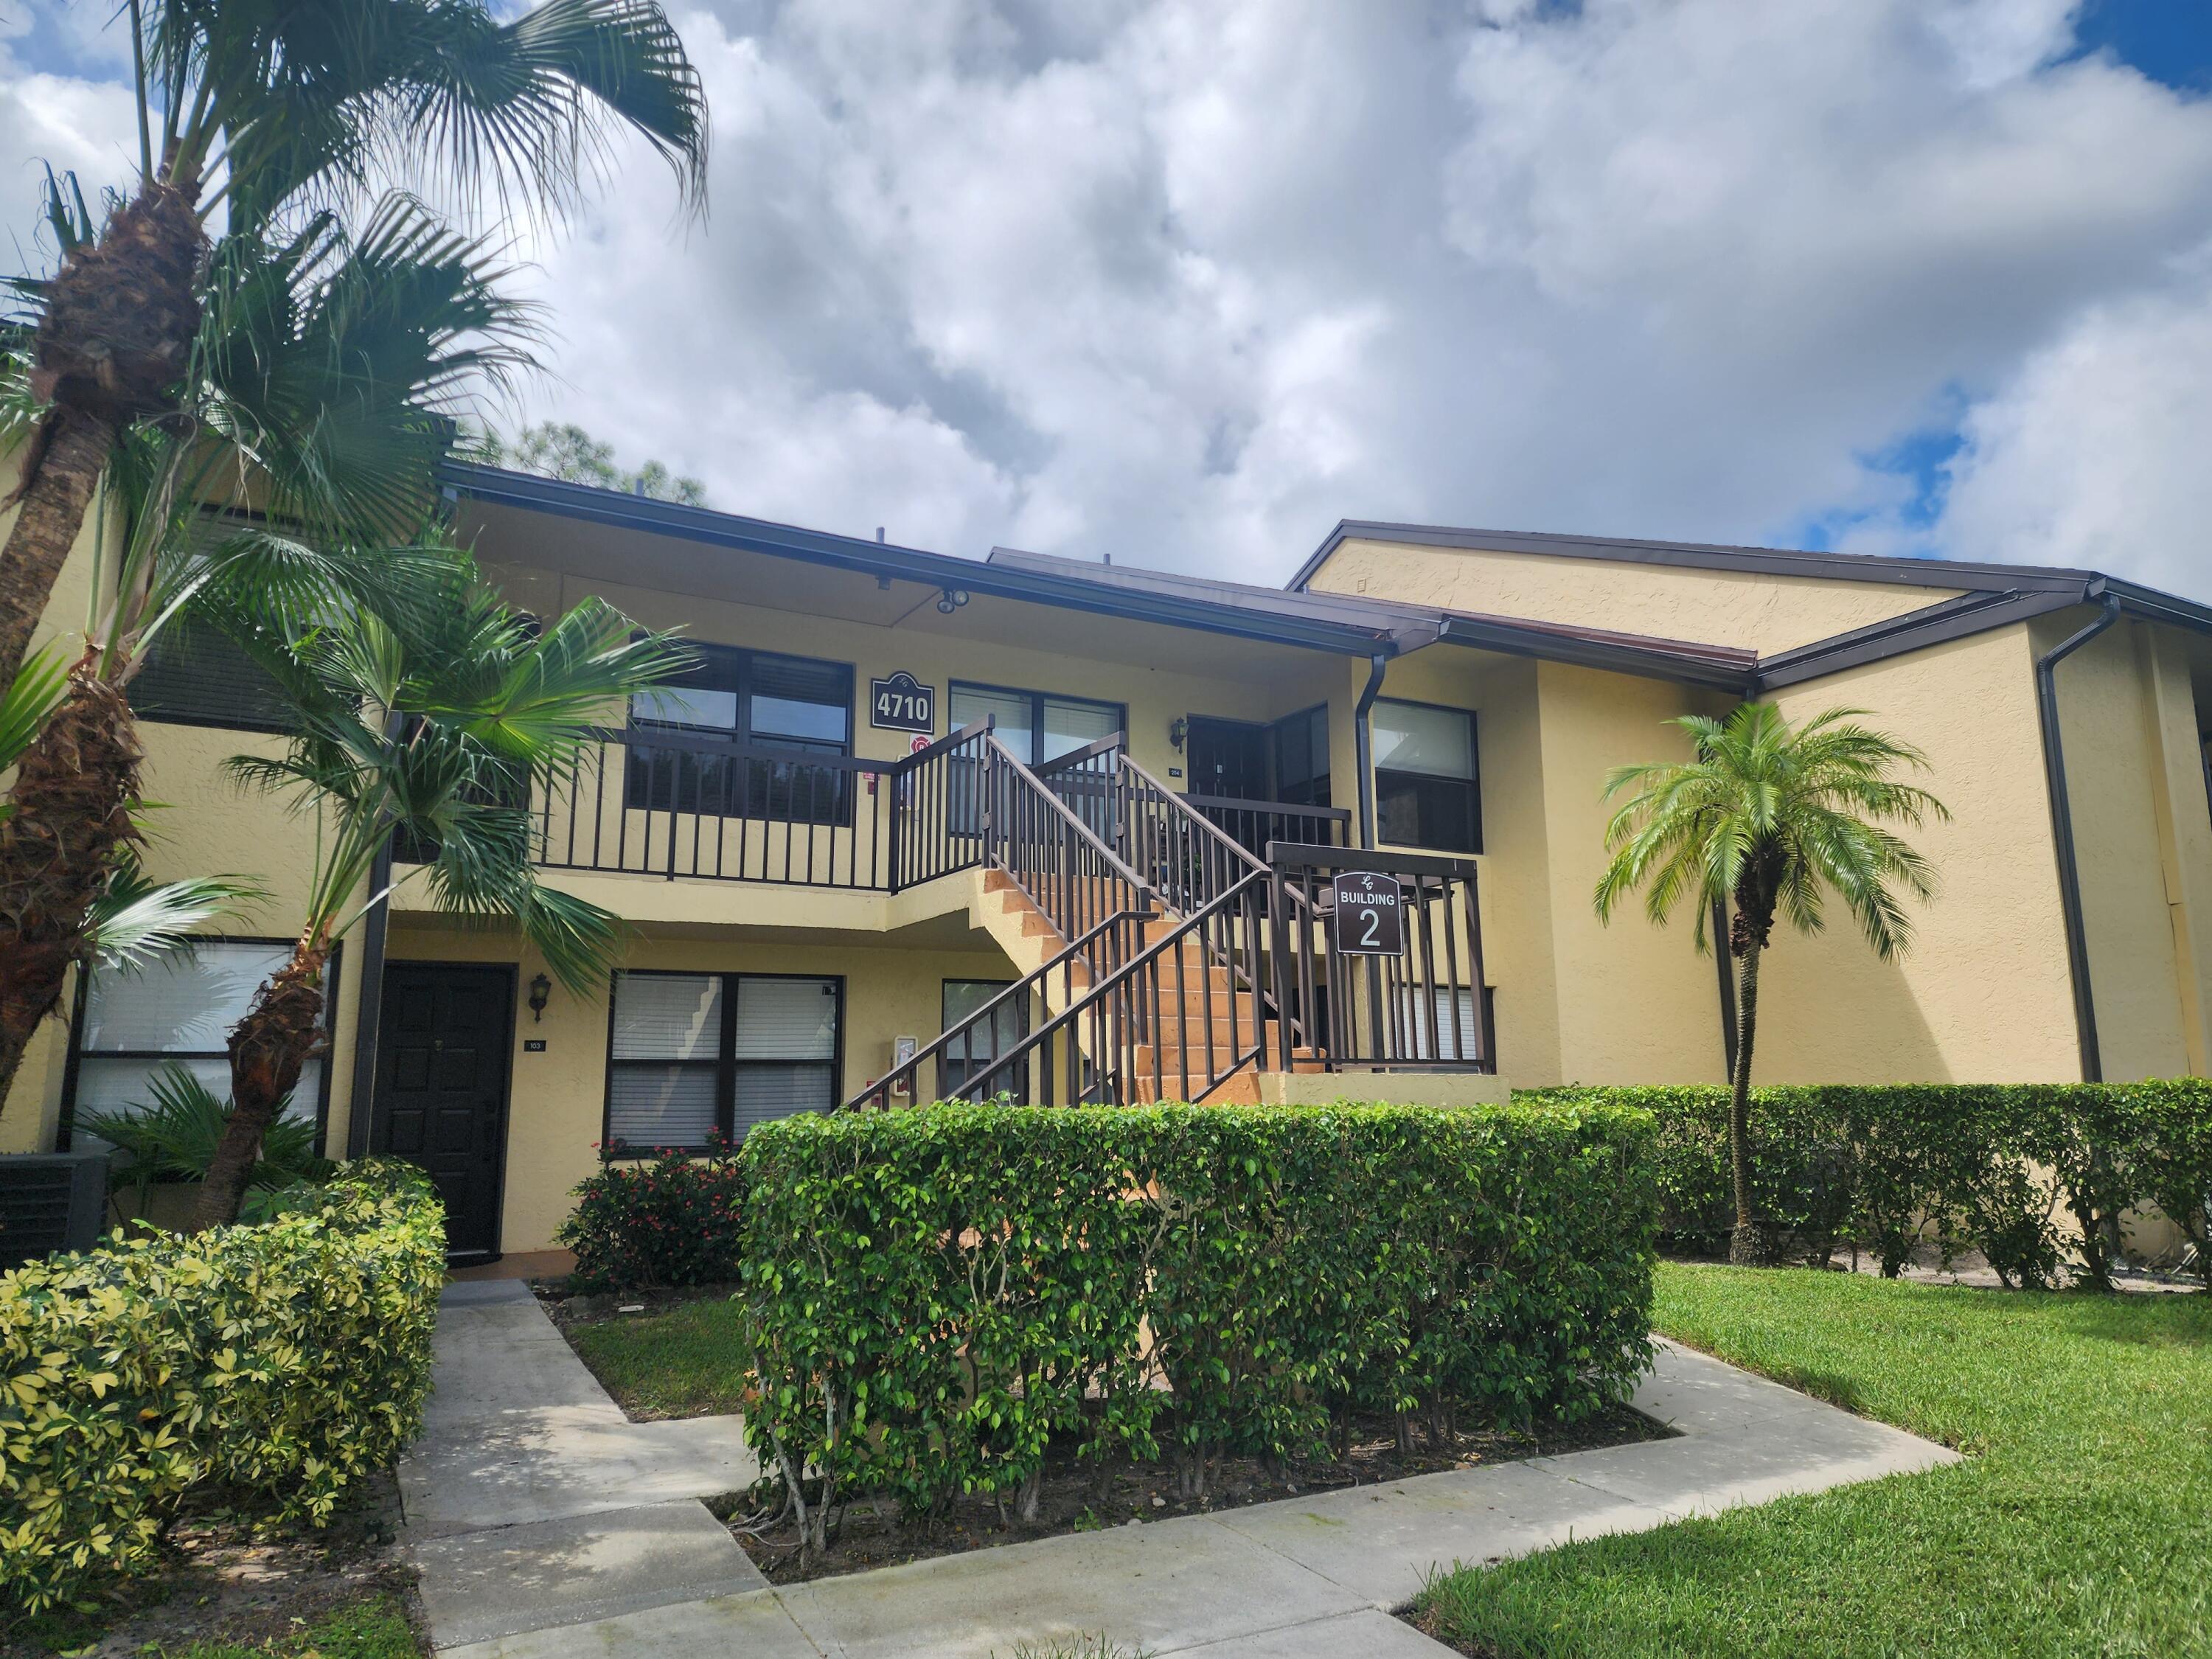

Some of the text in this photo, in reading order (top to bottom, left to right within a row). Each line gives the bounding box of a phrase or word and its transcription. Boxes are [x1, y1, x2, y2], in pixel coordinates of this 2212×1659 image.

[877, 692, 928, 721] 4710
[1340, 891, 1395, 905] BUILDING
[1360, 908, 1380, 947] 2
